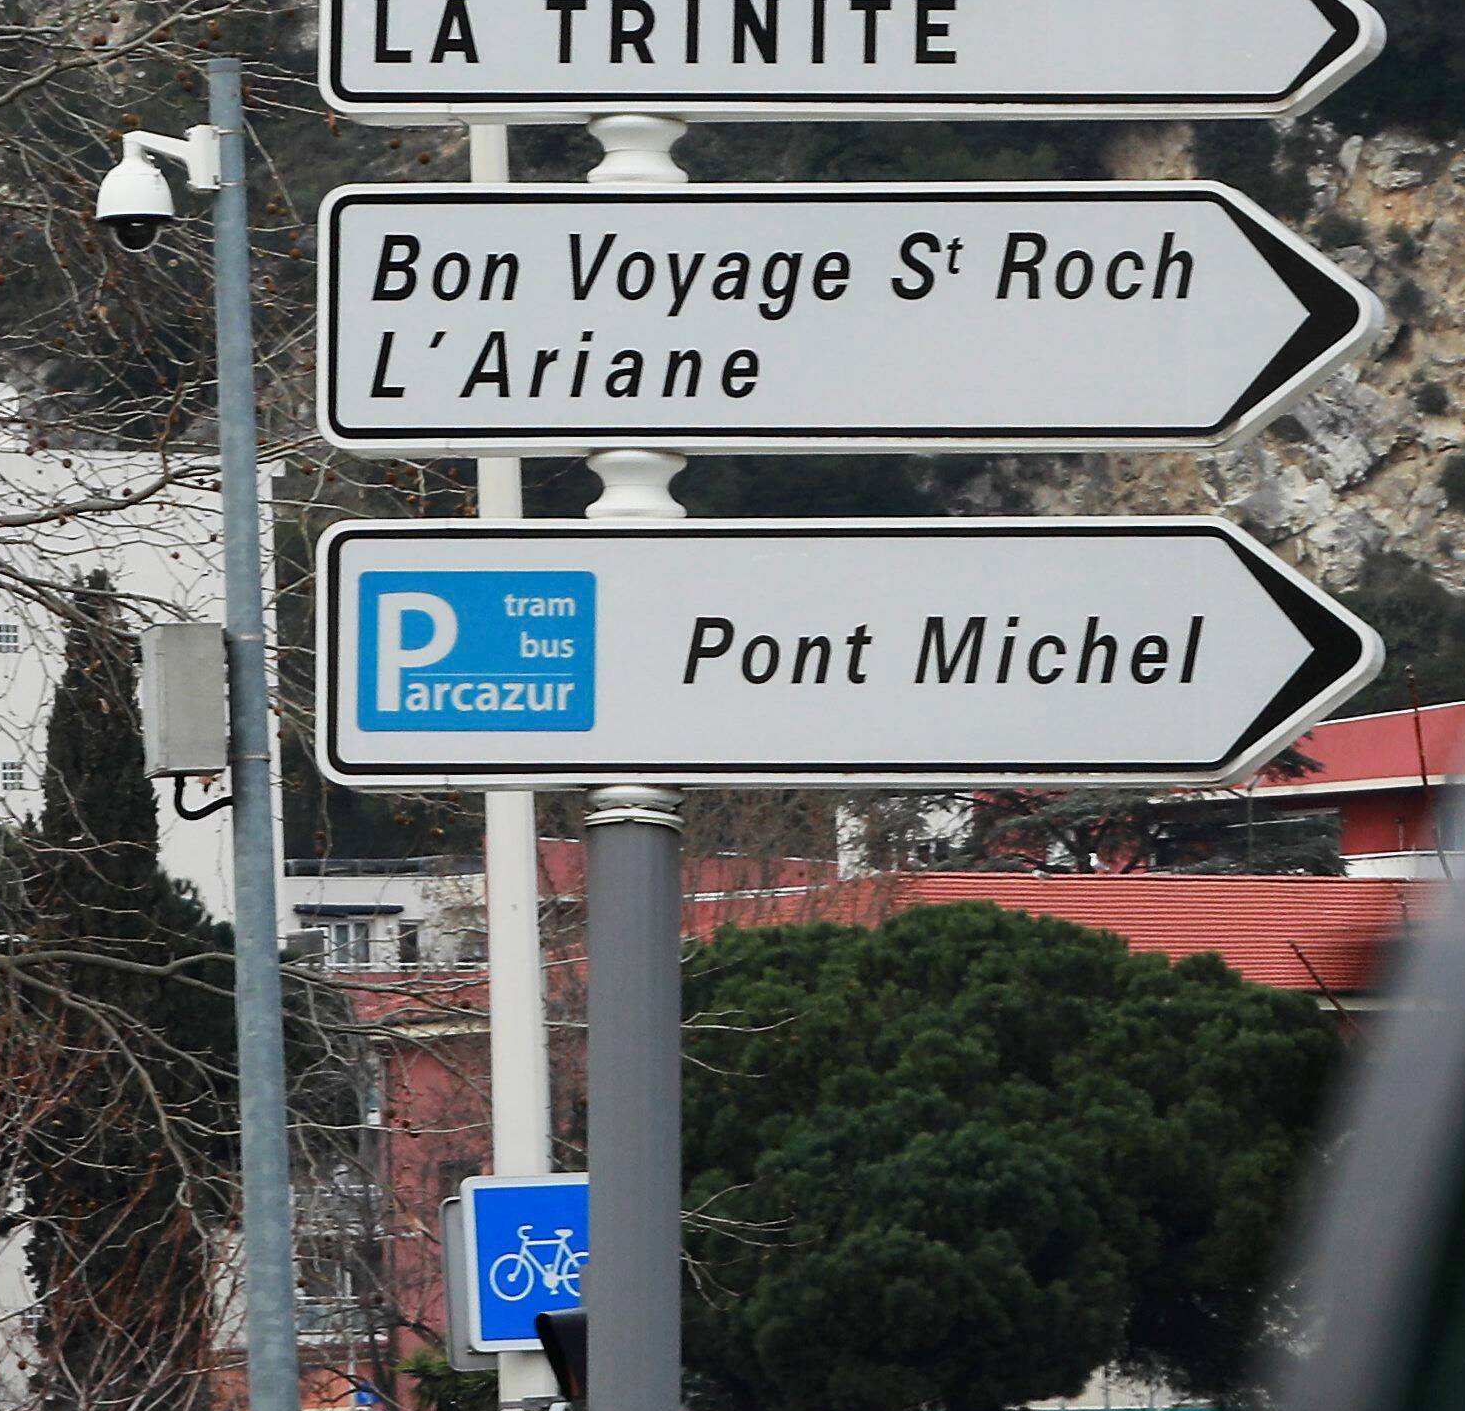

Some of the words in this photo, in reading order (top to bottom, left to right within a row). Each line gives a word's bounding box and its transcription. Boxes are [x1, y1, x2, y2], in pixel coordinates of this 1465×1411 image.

[370, 234, 520, 302] Bon
[568, 233, 851, 321] Voyage
[995, 231, 1194, 301] Roch
[369, 330, 760, 399] L'Ariane
[504, 594, 576, 617] tram
[520, 631, 574, 659] bus
[682, 616, 873, 685] Pont
[913, 615, 1205, 685] Michel
